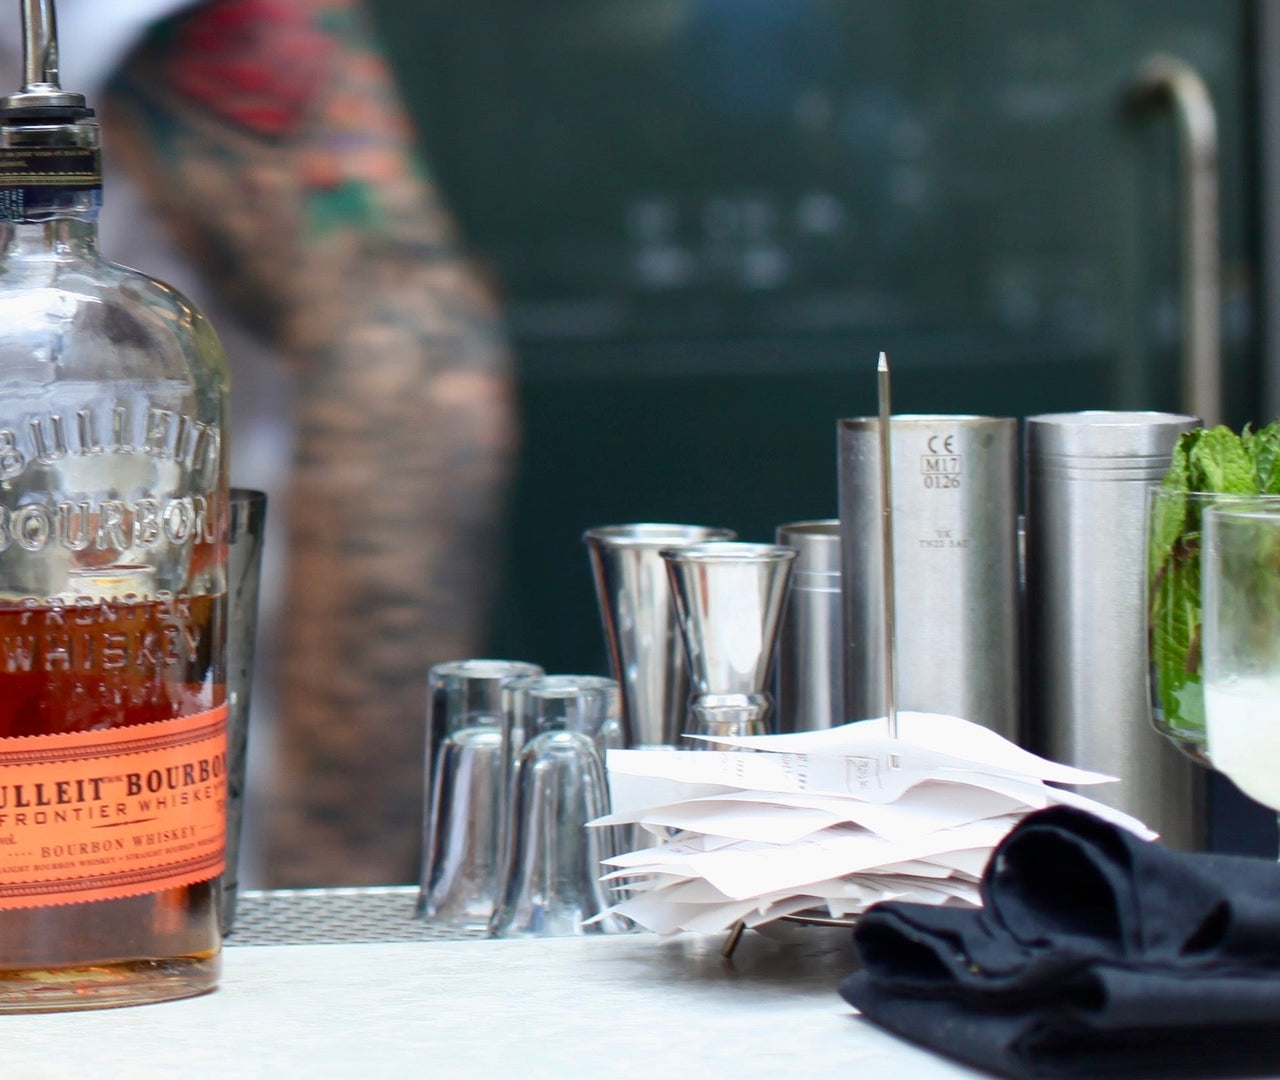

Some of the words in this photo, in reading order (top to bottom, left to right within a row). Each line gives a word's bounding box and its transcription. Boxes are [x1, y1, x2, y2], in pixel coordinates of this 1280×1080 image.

[923, 475, 961, 489] 0126
[925, 458, 958, 473] M17
[20, 590, 190, 625] FRONTIER
[3, 624, 201, 672] WHISKEY
[40, 837, 125, 859] BOURBON
[132, 824, 198, 848] WHISKEY
